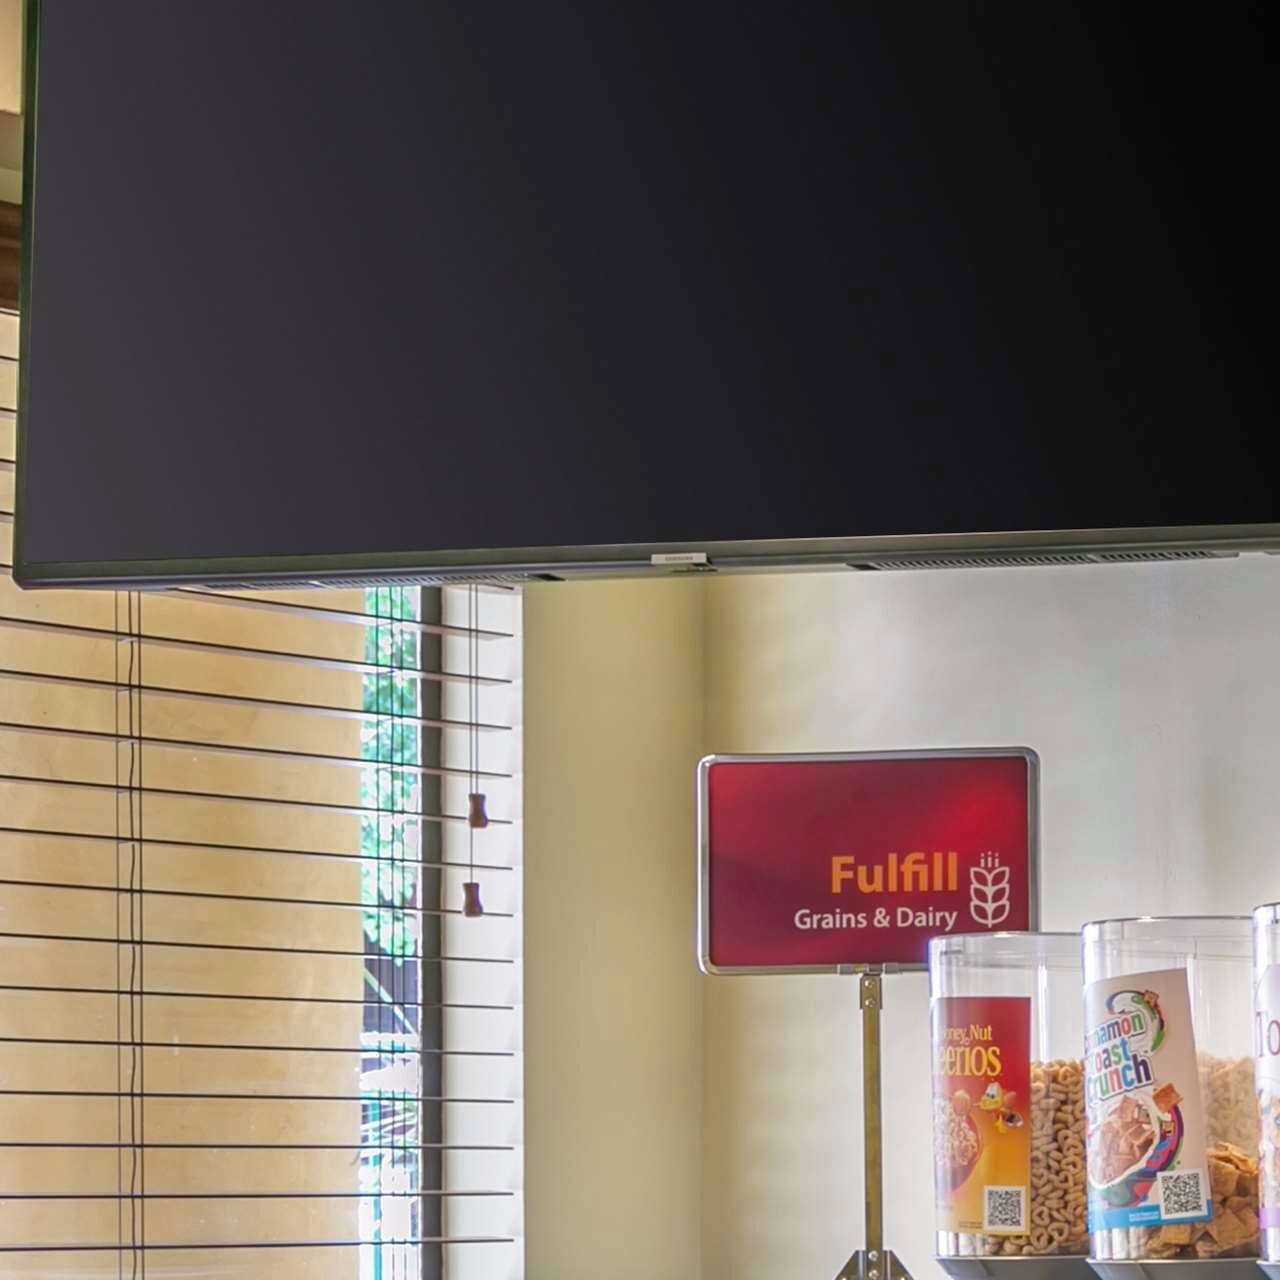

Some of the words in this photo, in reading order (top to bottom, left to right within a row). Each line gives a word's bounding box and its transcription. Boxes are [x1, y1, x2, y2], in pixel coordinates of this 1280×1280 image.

[831, 852, 958, 893] Fulfill
[794, 908, 867, 930] Grains
[873, 907, 890, 928] &
[897, 907, 958, 931] Dairy
[969, 1024, 993, 1041] Nut
